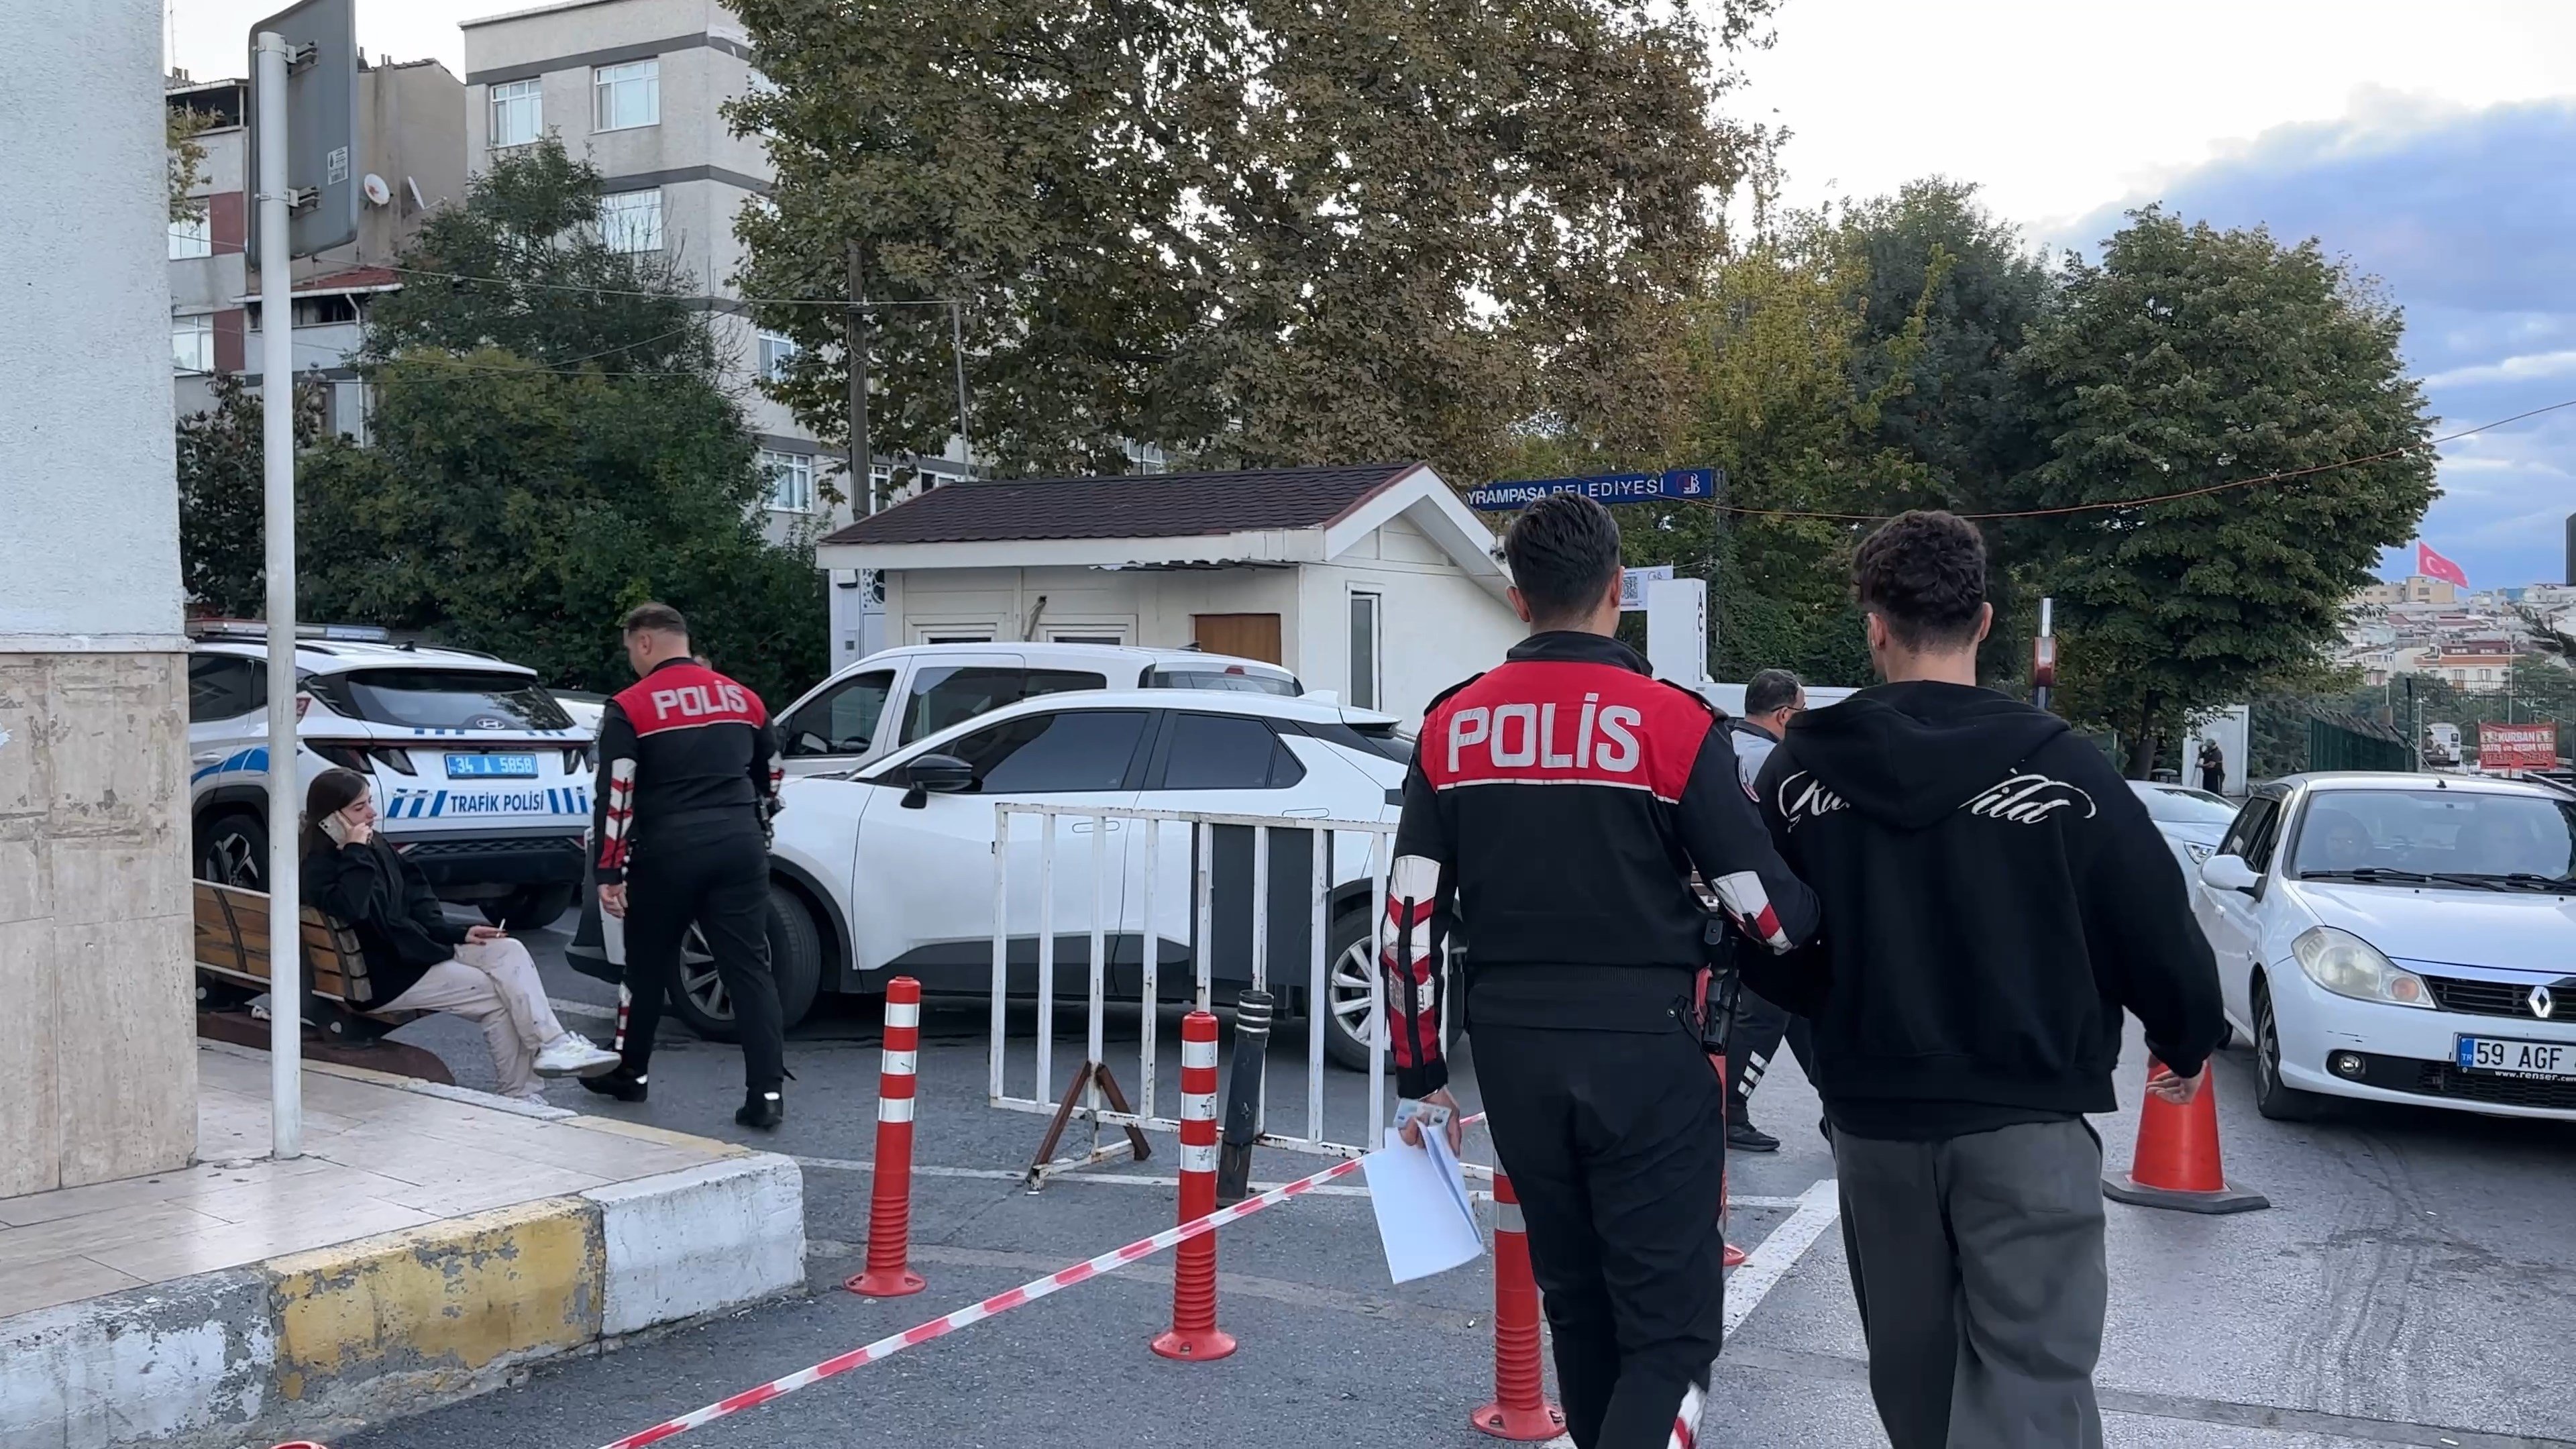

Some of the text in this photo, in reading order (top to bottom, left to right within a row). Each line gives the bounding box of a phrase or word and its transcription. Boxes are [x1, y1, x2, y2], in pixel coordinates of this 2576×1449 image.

[651, 680, 749, 720] POLİS
[1448, 692, 1642, 773] POLİS
[2498, 731, 2535, 743] KURBAN
[455, 757, 533, 773] 34 A 5858
[450, 791, 544, 812] TRAFİK POLİSİ
[2461, 1042, 2563, 1070] TR 59 AGF
